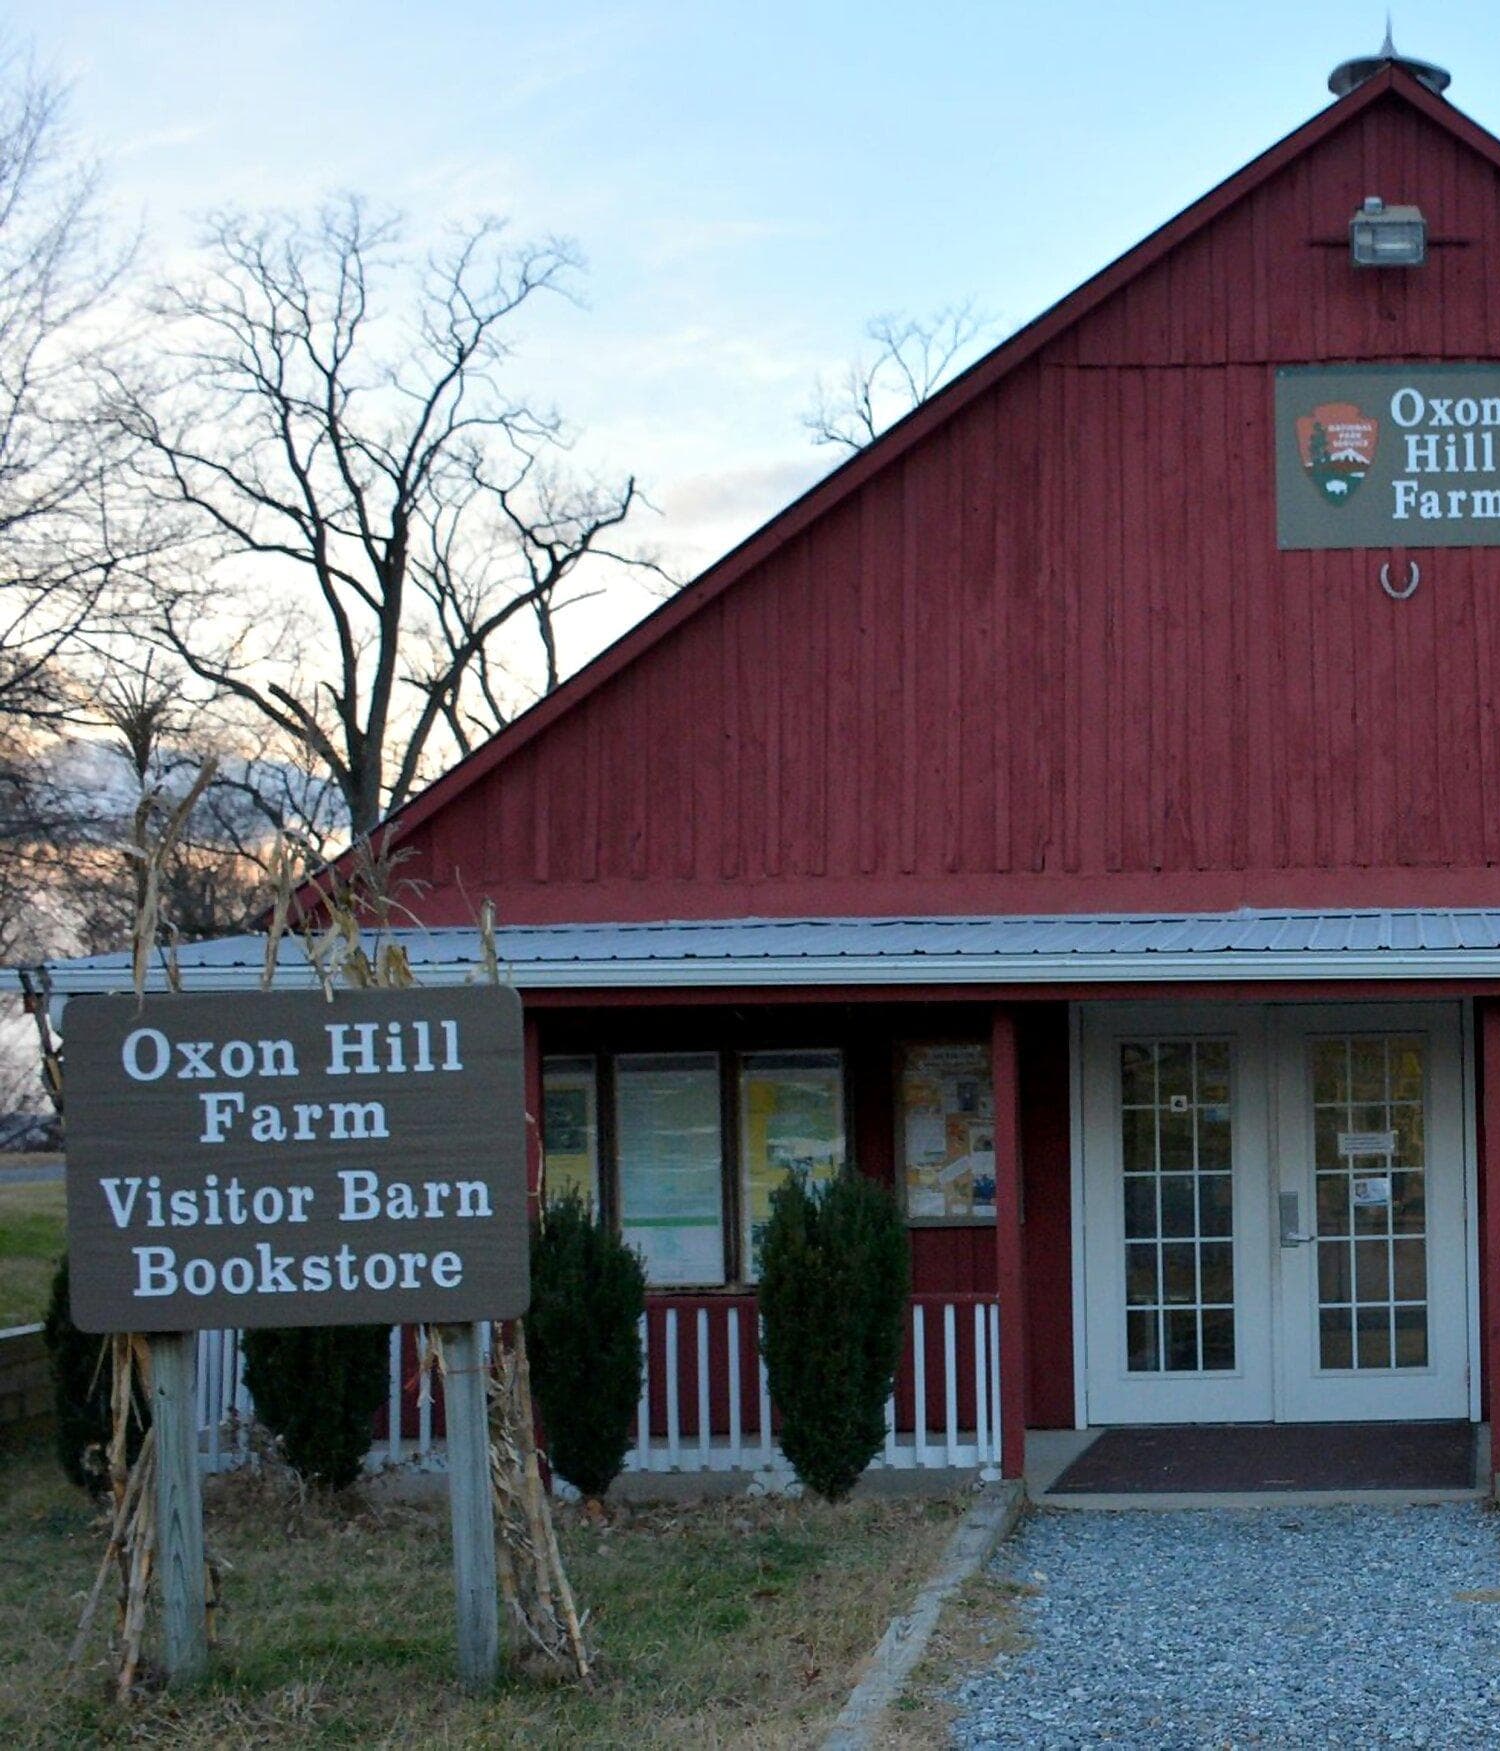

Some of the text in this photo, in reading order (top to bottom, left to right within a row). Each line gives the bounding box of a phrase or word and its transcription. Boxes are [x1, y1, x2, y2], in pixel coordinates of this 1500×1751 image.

[1404, 431, 1496, 473] Hill
[121, 1019, 464, 1082] Oxon Hill
[199, 1091, 390, 1143] Farm
[100, 1169, 493, 1229] Visitor Barn
[131, 1241, 464, 1298] Bookstore
